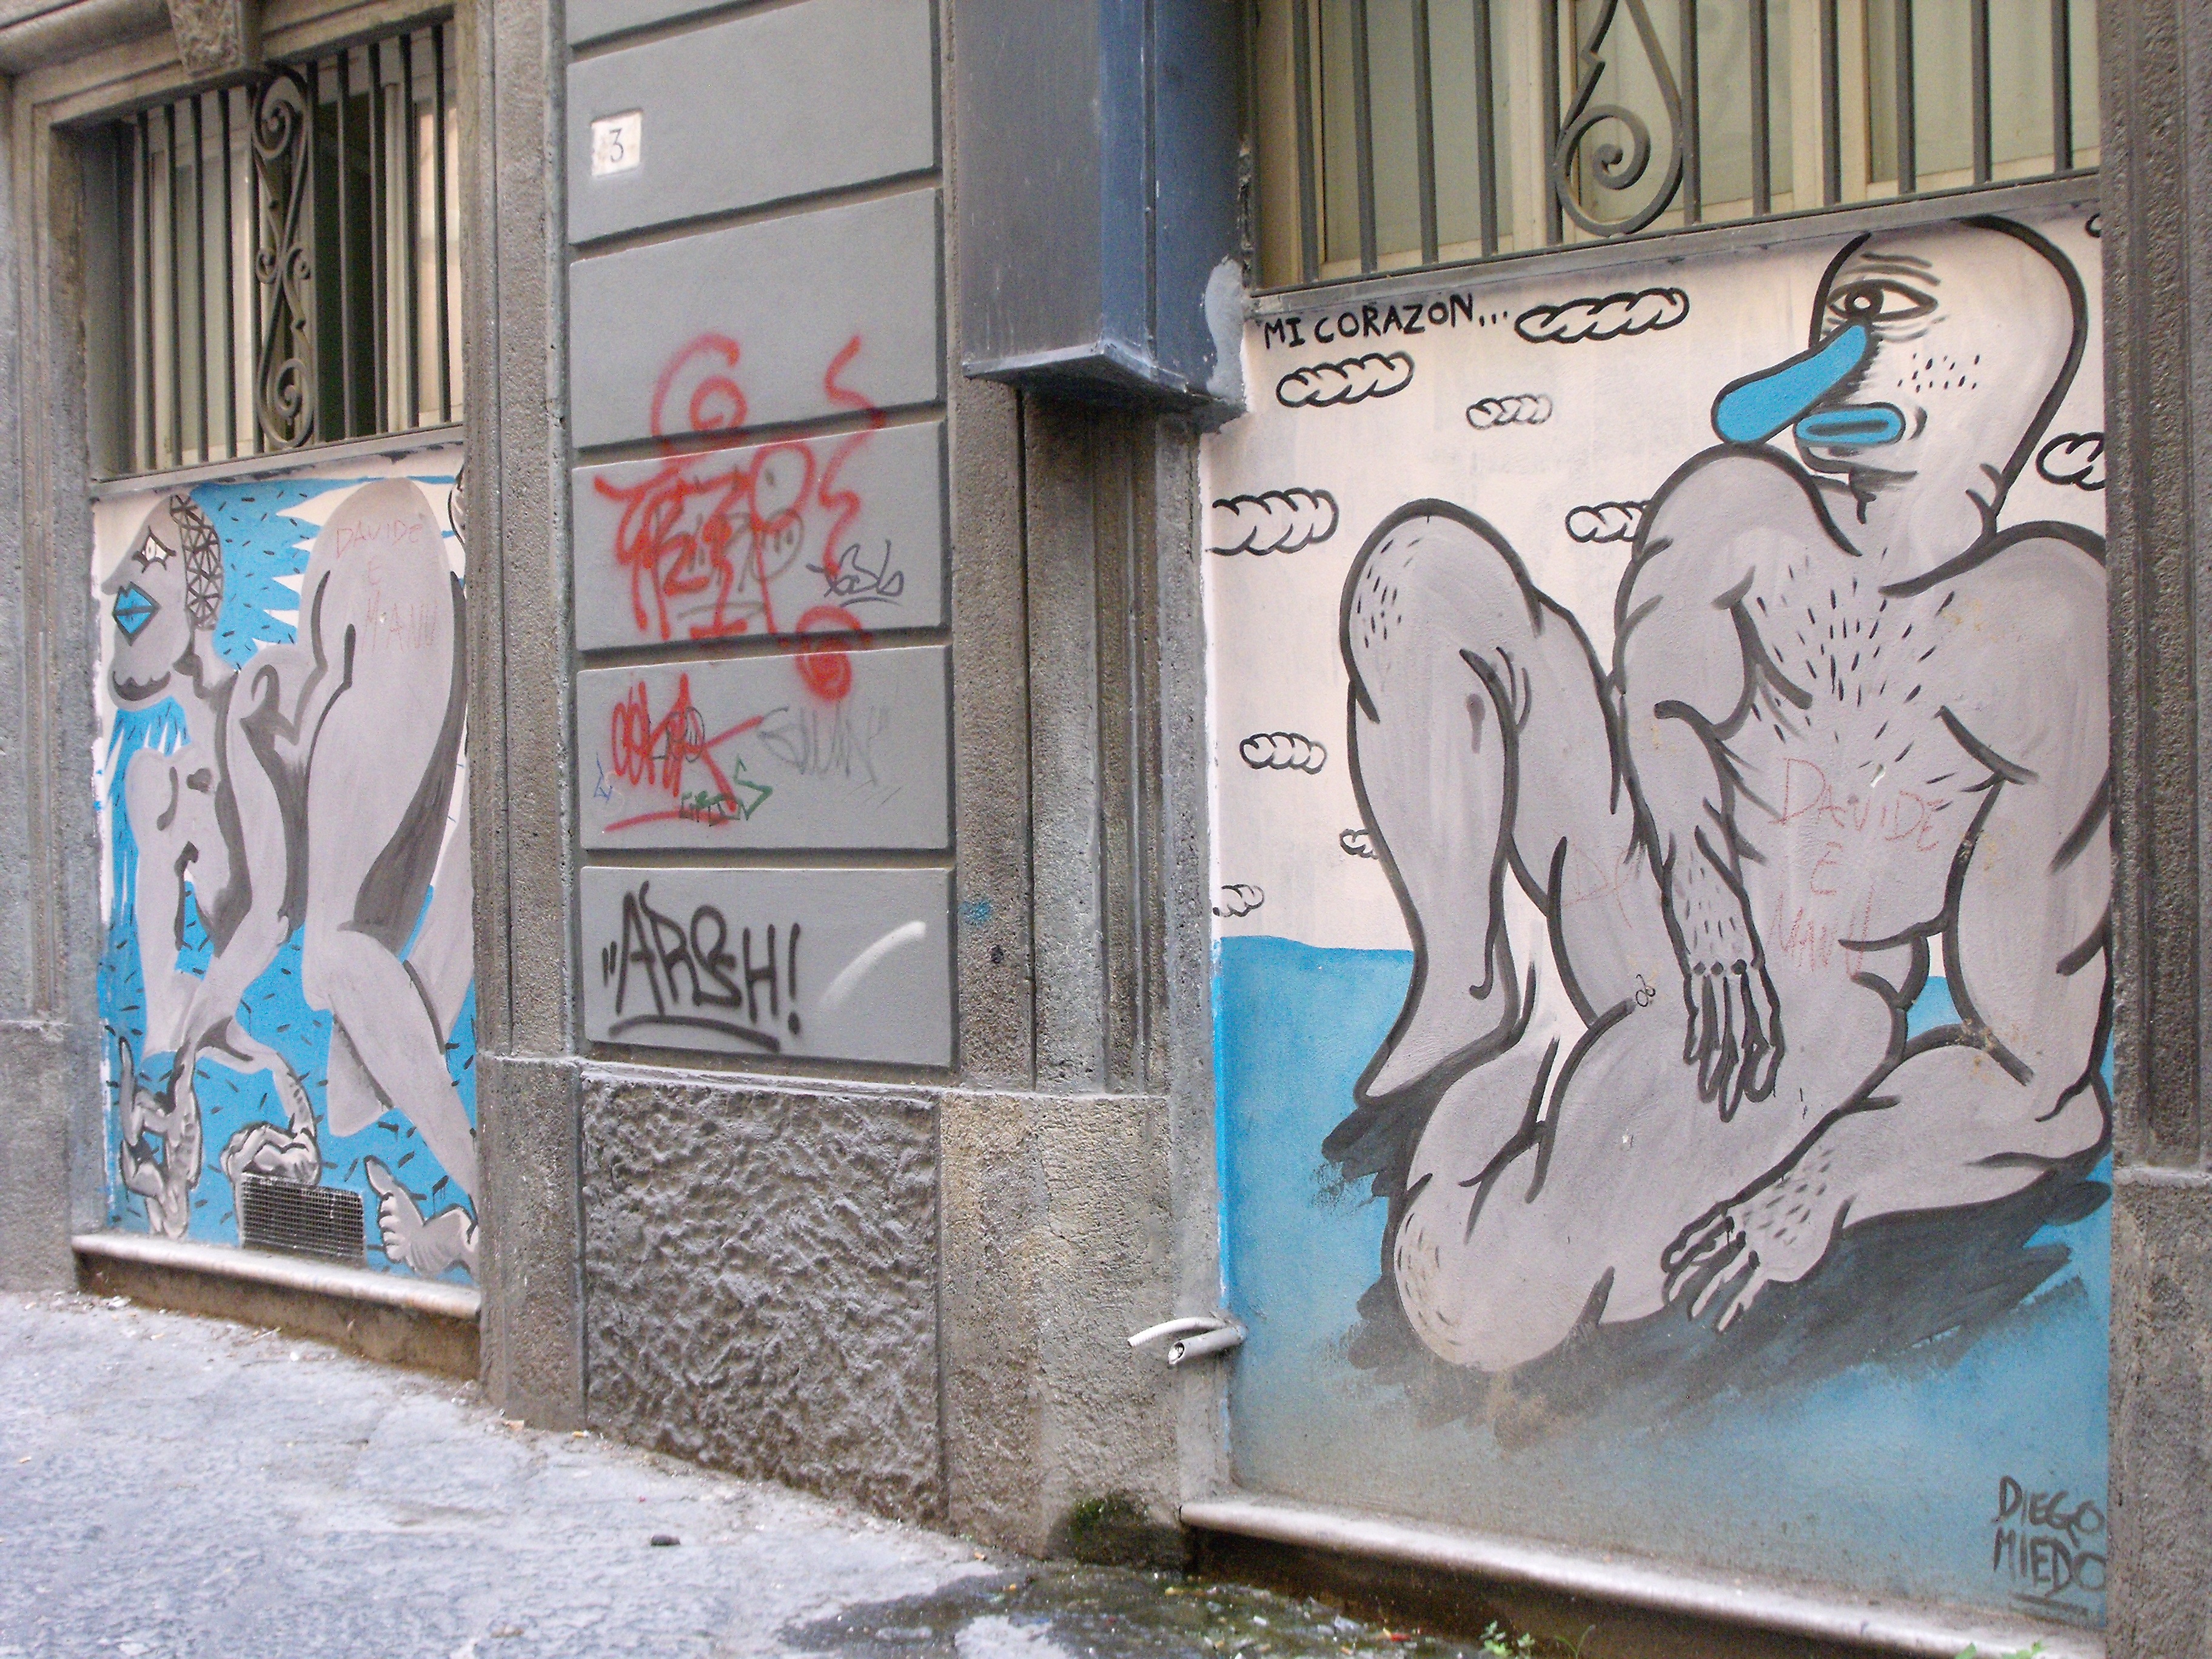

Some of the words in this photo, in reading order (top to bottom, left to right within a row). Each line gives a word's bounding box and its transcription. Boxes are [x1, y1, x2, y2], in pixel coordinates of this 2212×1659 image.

[609, 127, 624, 163] 3
[1264, 321, 1305, 348] MI
[1991, 1475, 2105, 1548] DIEGO
[1992, 1526, 2106, 1597] MIEDO
